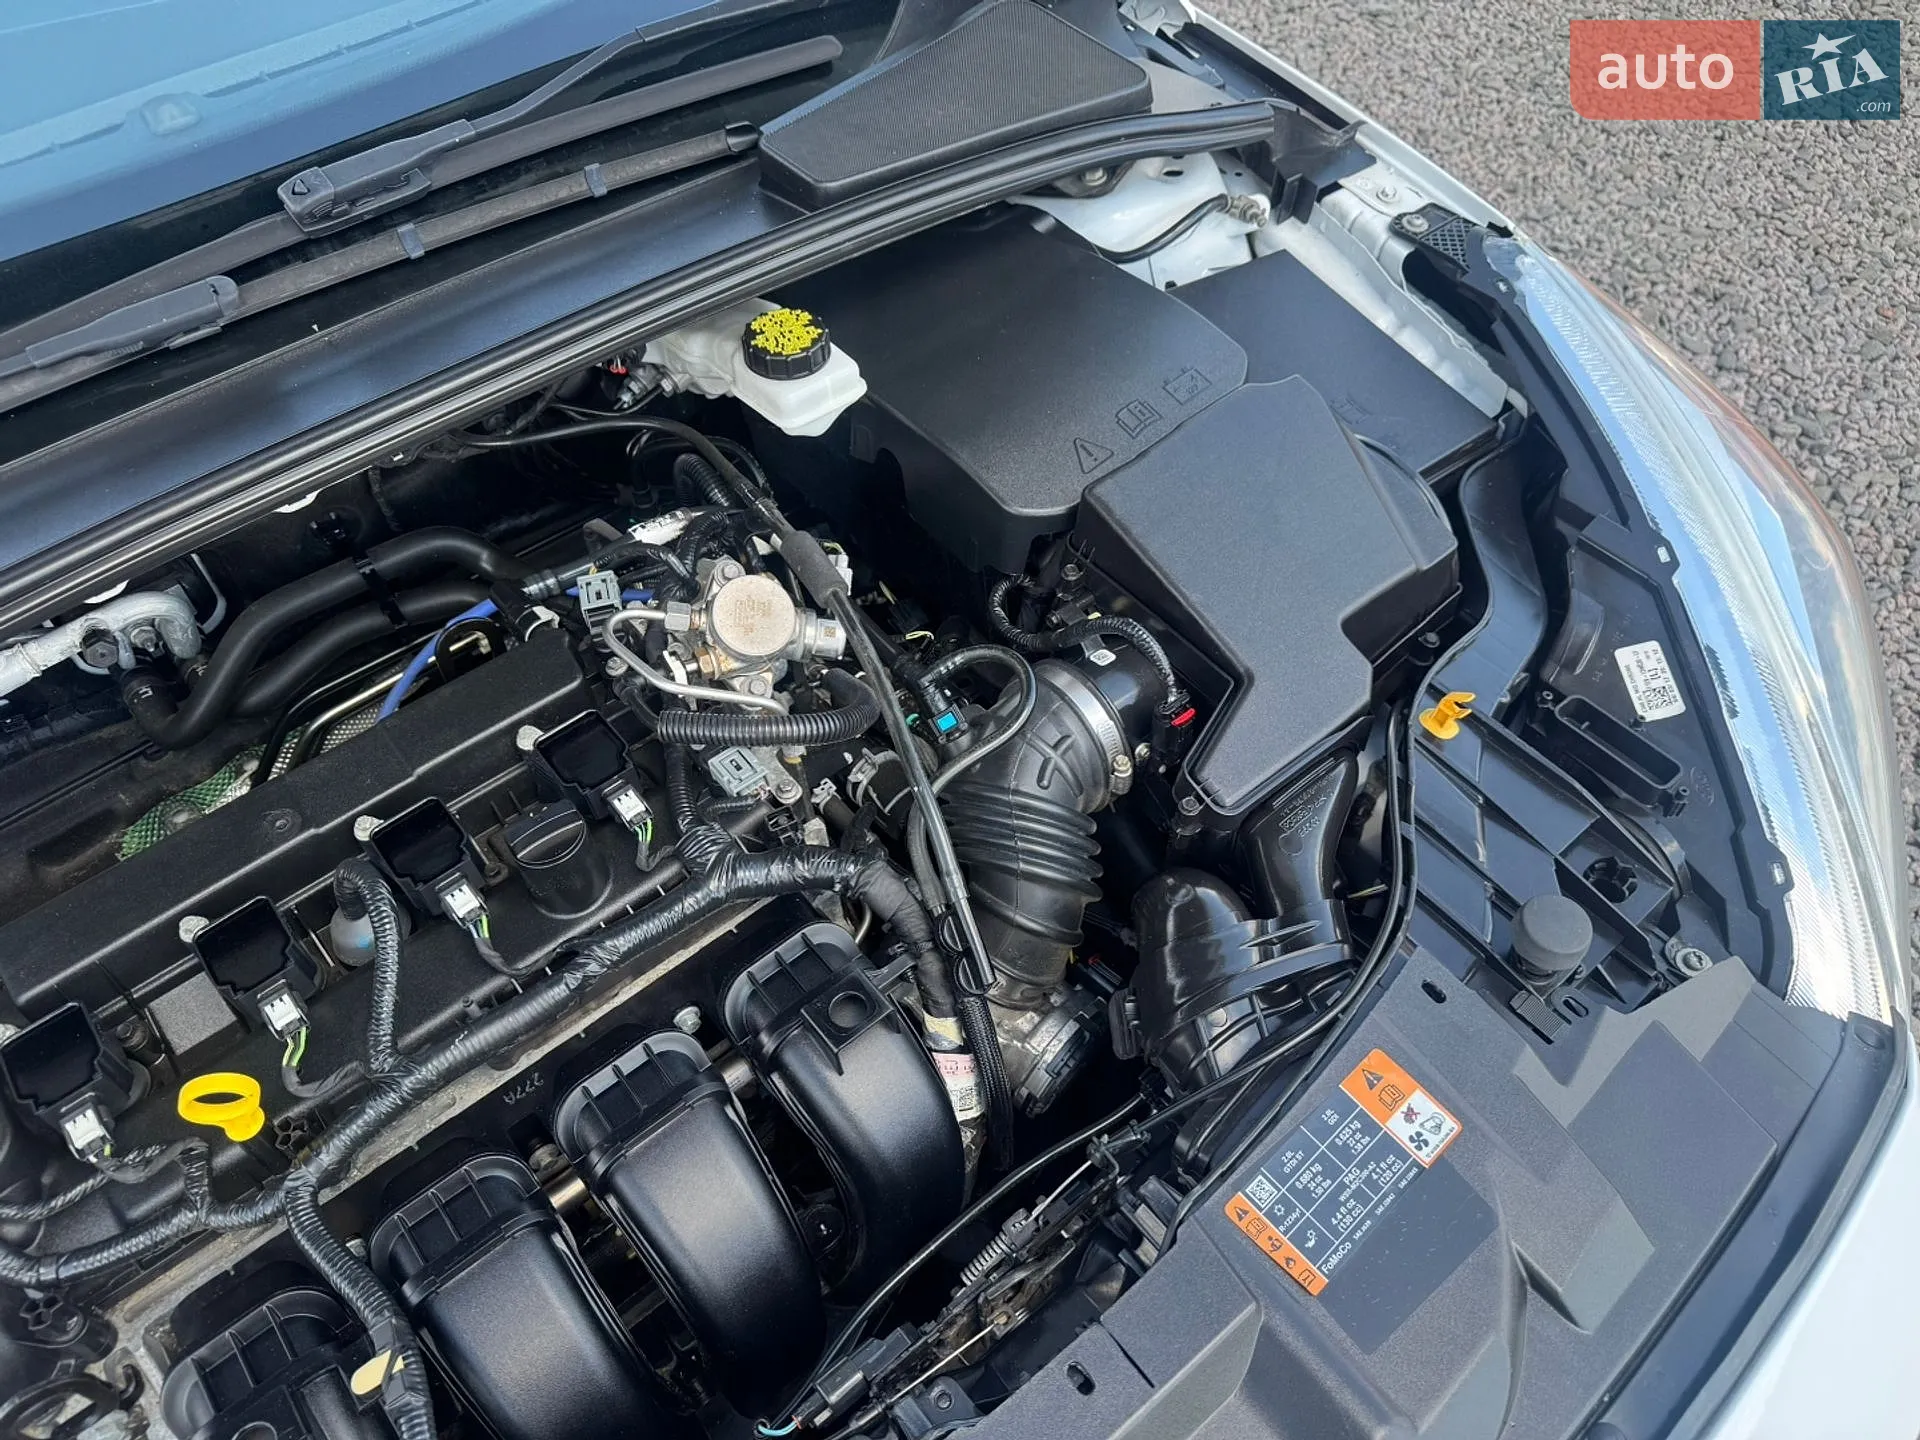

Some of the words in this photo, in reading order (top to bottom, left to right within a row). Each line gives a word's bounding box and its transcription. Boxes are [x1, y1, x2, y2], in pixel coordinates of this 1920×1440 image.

[1348, 1119, 1361, 1132] kg
[1353, 1131, 1362, 1140] oz
[1360, 1135, 1371, 1145] lbs
[1309, 1161, 1323, 1175] kg
[1370, 1166, 1384, 1180] 4.1
[1379, 1161, 1388, 1170] fl
[1385, 1154, 1396, 1164] oz
[1389, 1158, 1404, 1173] cc)
[1314, 1174, 1323, 1184] oz
[1343, 1166, 1360, 1185] PAG
[1320, 1177, 1332, 1189] lbs
[1329, 1211, 1343, 1225] 4.4
[1339, 1205, 1348, 1215] fl
[1345, 1198, 1356, 1209] oz
[1349, 1203, 1364, 1218] cc)
[1320, 1240, 1353, 1274] FoMoCo
